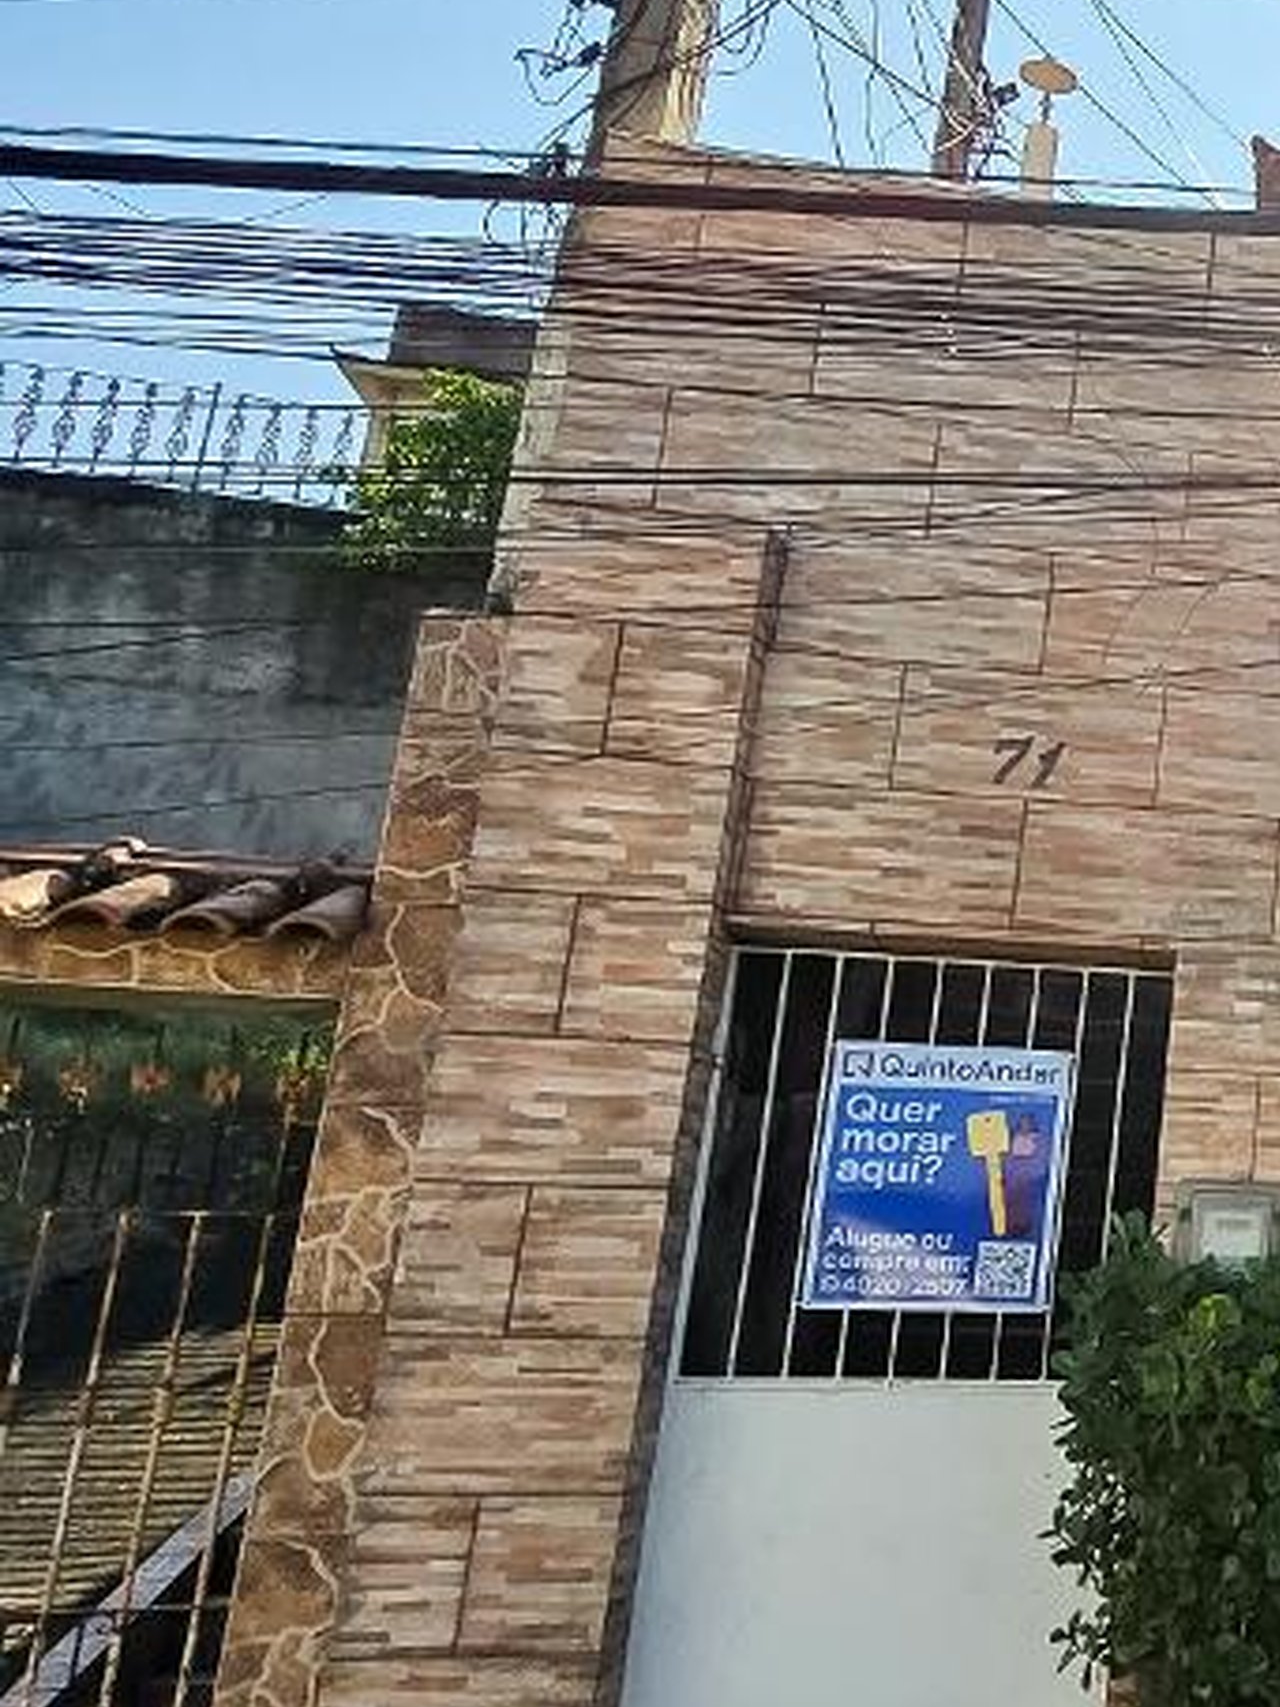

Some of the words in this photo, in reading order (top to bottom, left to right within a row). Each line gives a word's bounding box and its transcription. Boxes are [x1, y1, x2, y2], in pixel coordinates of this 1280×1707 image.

[880, 1051, 1061, 1085] QuintoAndar
[845, 1093, 944, 1123] Quer
[841, 1128, 957, 1155] morar
[834, 1156, 944, 1190] aqui?
[825, 1225, 917, 1253] Alugue
[921, 1233, 953, 1251] ou
